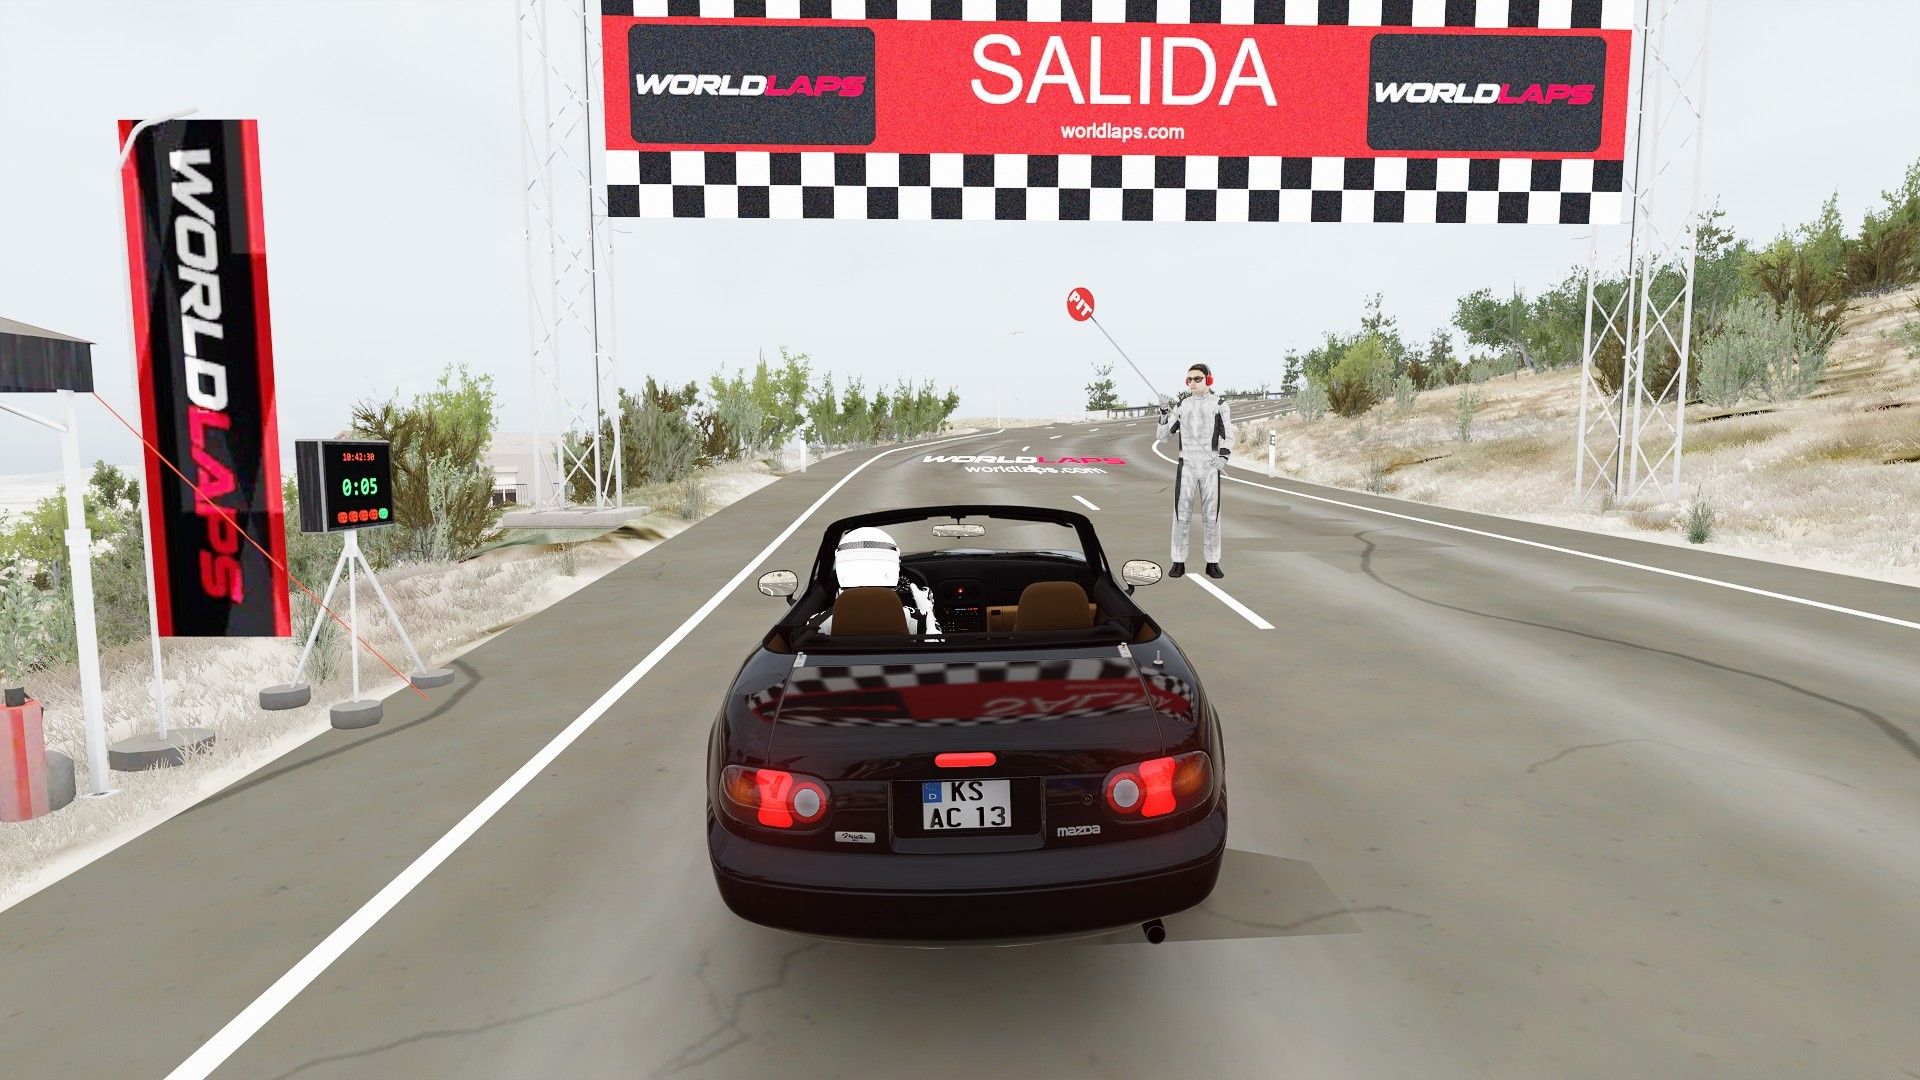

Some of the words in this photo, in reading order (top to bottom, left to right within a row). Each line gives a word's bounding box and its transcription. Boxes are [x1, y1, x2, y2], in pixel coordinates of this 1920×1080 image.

[970, 33, 1278, 107] SALIDA
[635, 73, 867, 97] WORLDLAPS
[1374, 82, 1596, 105] WORLDLAPS
[1060, 122, 1186, 143] worldlaps.com
[1069, 290, 1092, 317] PIT
[168, 148, 243, 604] WORLDLAPS
[922, 455, 1127, 465] WORLDLAPS
[964, 464, 1108, 475] worldlaps.com
[342, 477, 378, 497] 0:05
[950, 780, 984, 802] KS
[929, 806, 962, 829] AC
[976, 806, 1006, 828] 13
